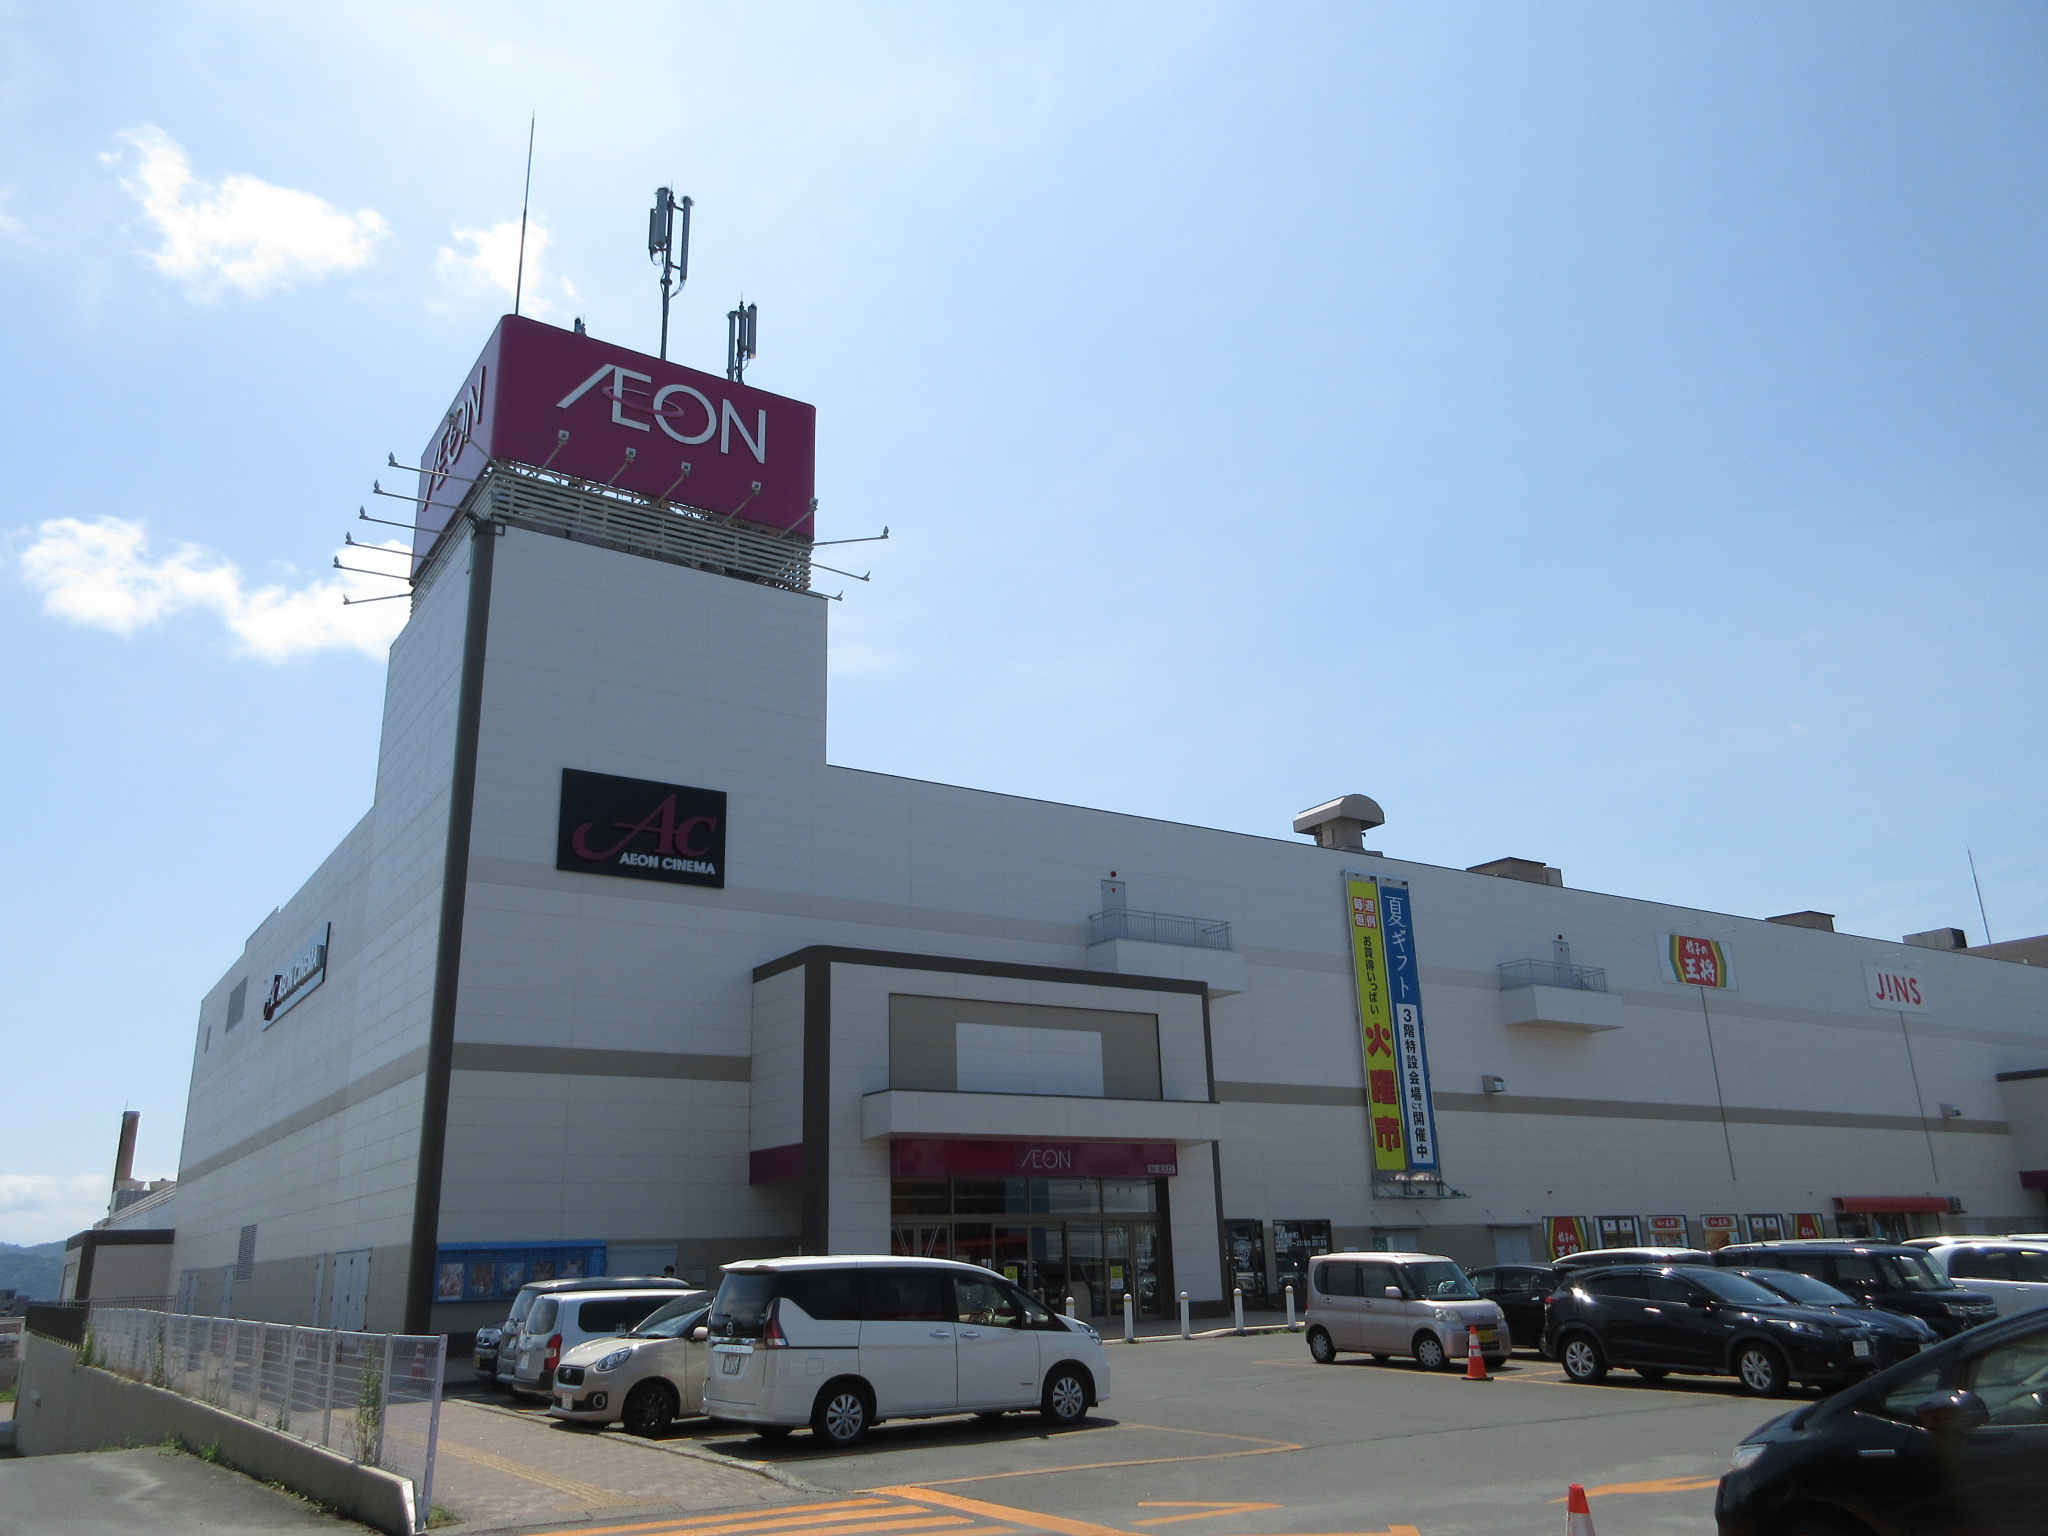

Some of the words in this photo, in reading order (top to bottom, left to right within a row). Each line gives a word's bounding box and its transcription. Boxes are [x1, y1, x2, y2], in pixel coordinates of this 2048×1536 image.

[619, 852, 659, 869] AEON
[661, 857, 716, 875] CINEMA
[1363, 936, 1380, 1016] お買得いっぱい
[1385, 895, 1411, 1000] 夏ギフト
[1683, 957, 1716, 983] 王将
[1365, 1022, 1401, 1153] 火曜市
